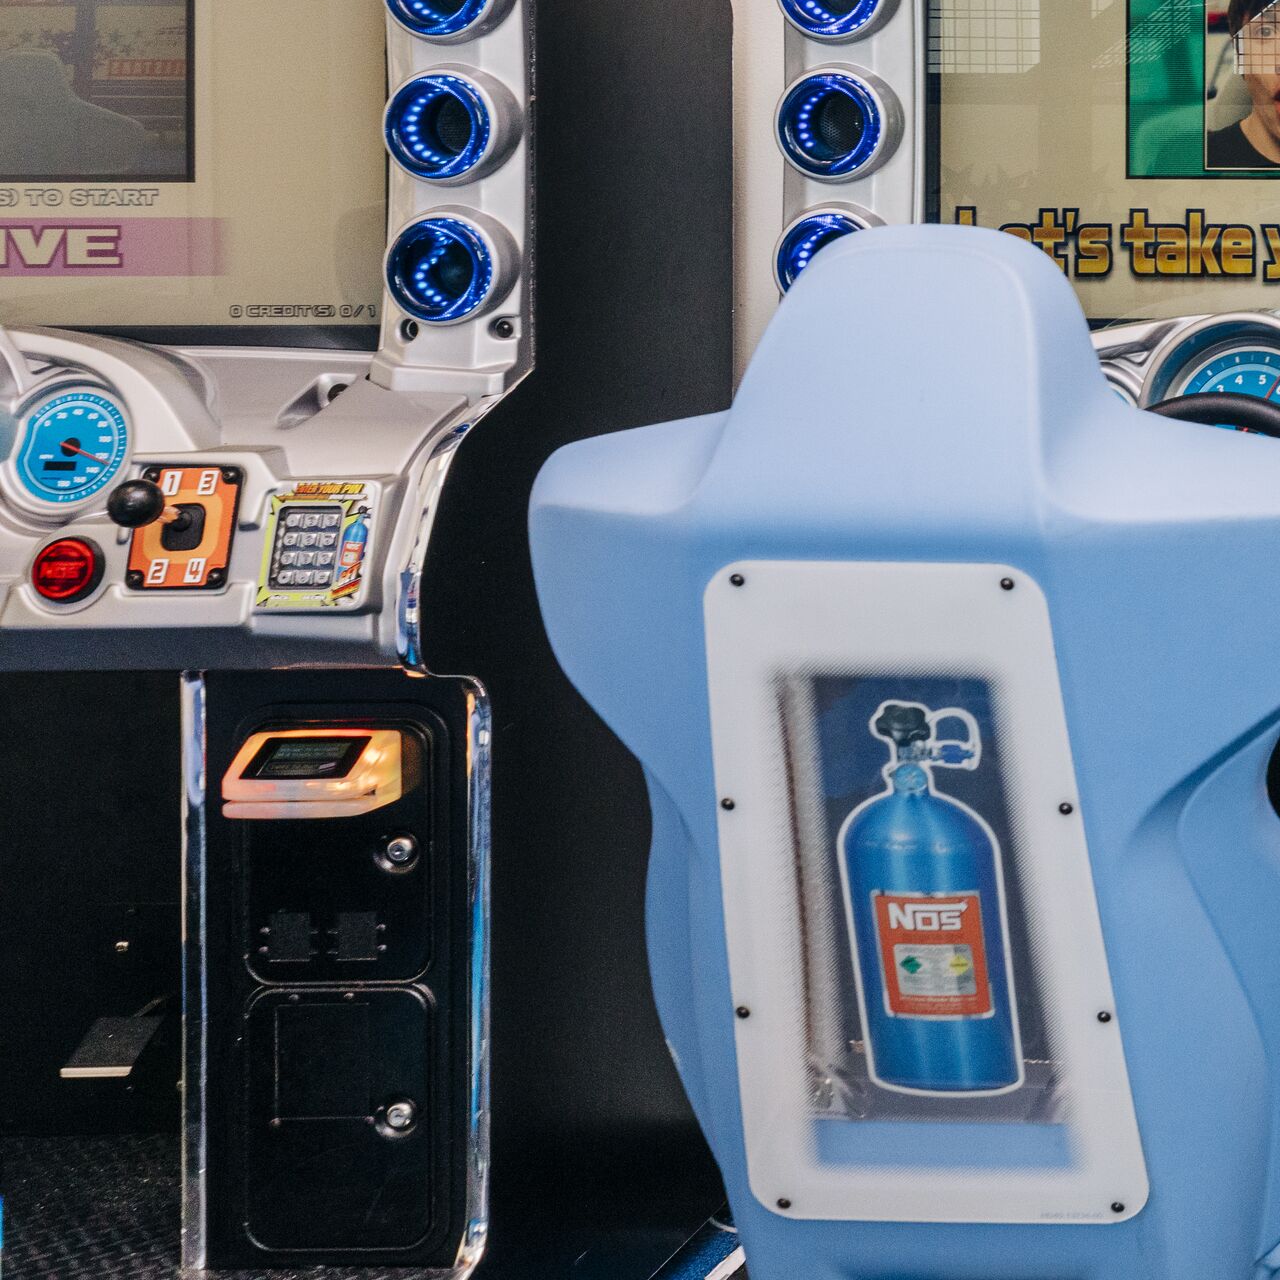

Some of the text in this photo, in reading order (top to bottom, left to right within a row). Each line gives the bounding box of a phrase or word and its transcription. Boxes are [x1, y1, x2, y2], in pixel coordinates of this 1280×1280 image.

[25, 189, 160, 207] TO START
[1121, 206, 1256, 280] take
[245, 305, 336, 318] CREDIT(S)
[887, 901, 968, 931] NOS
